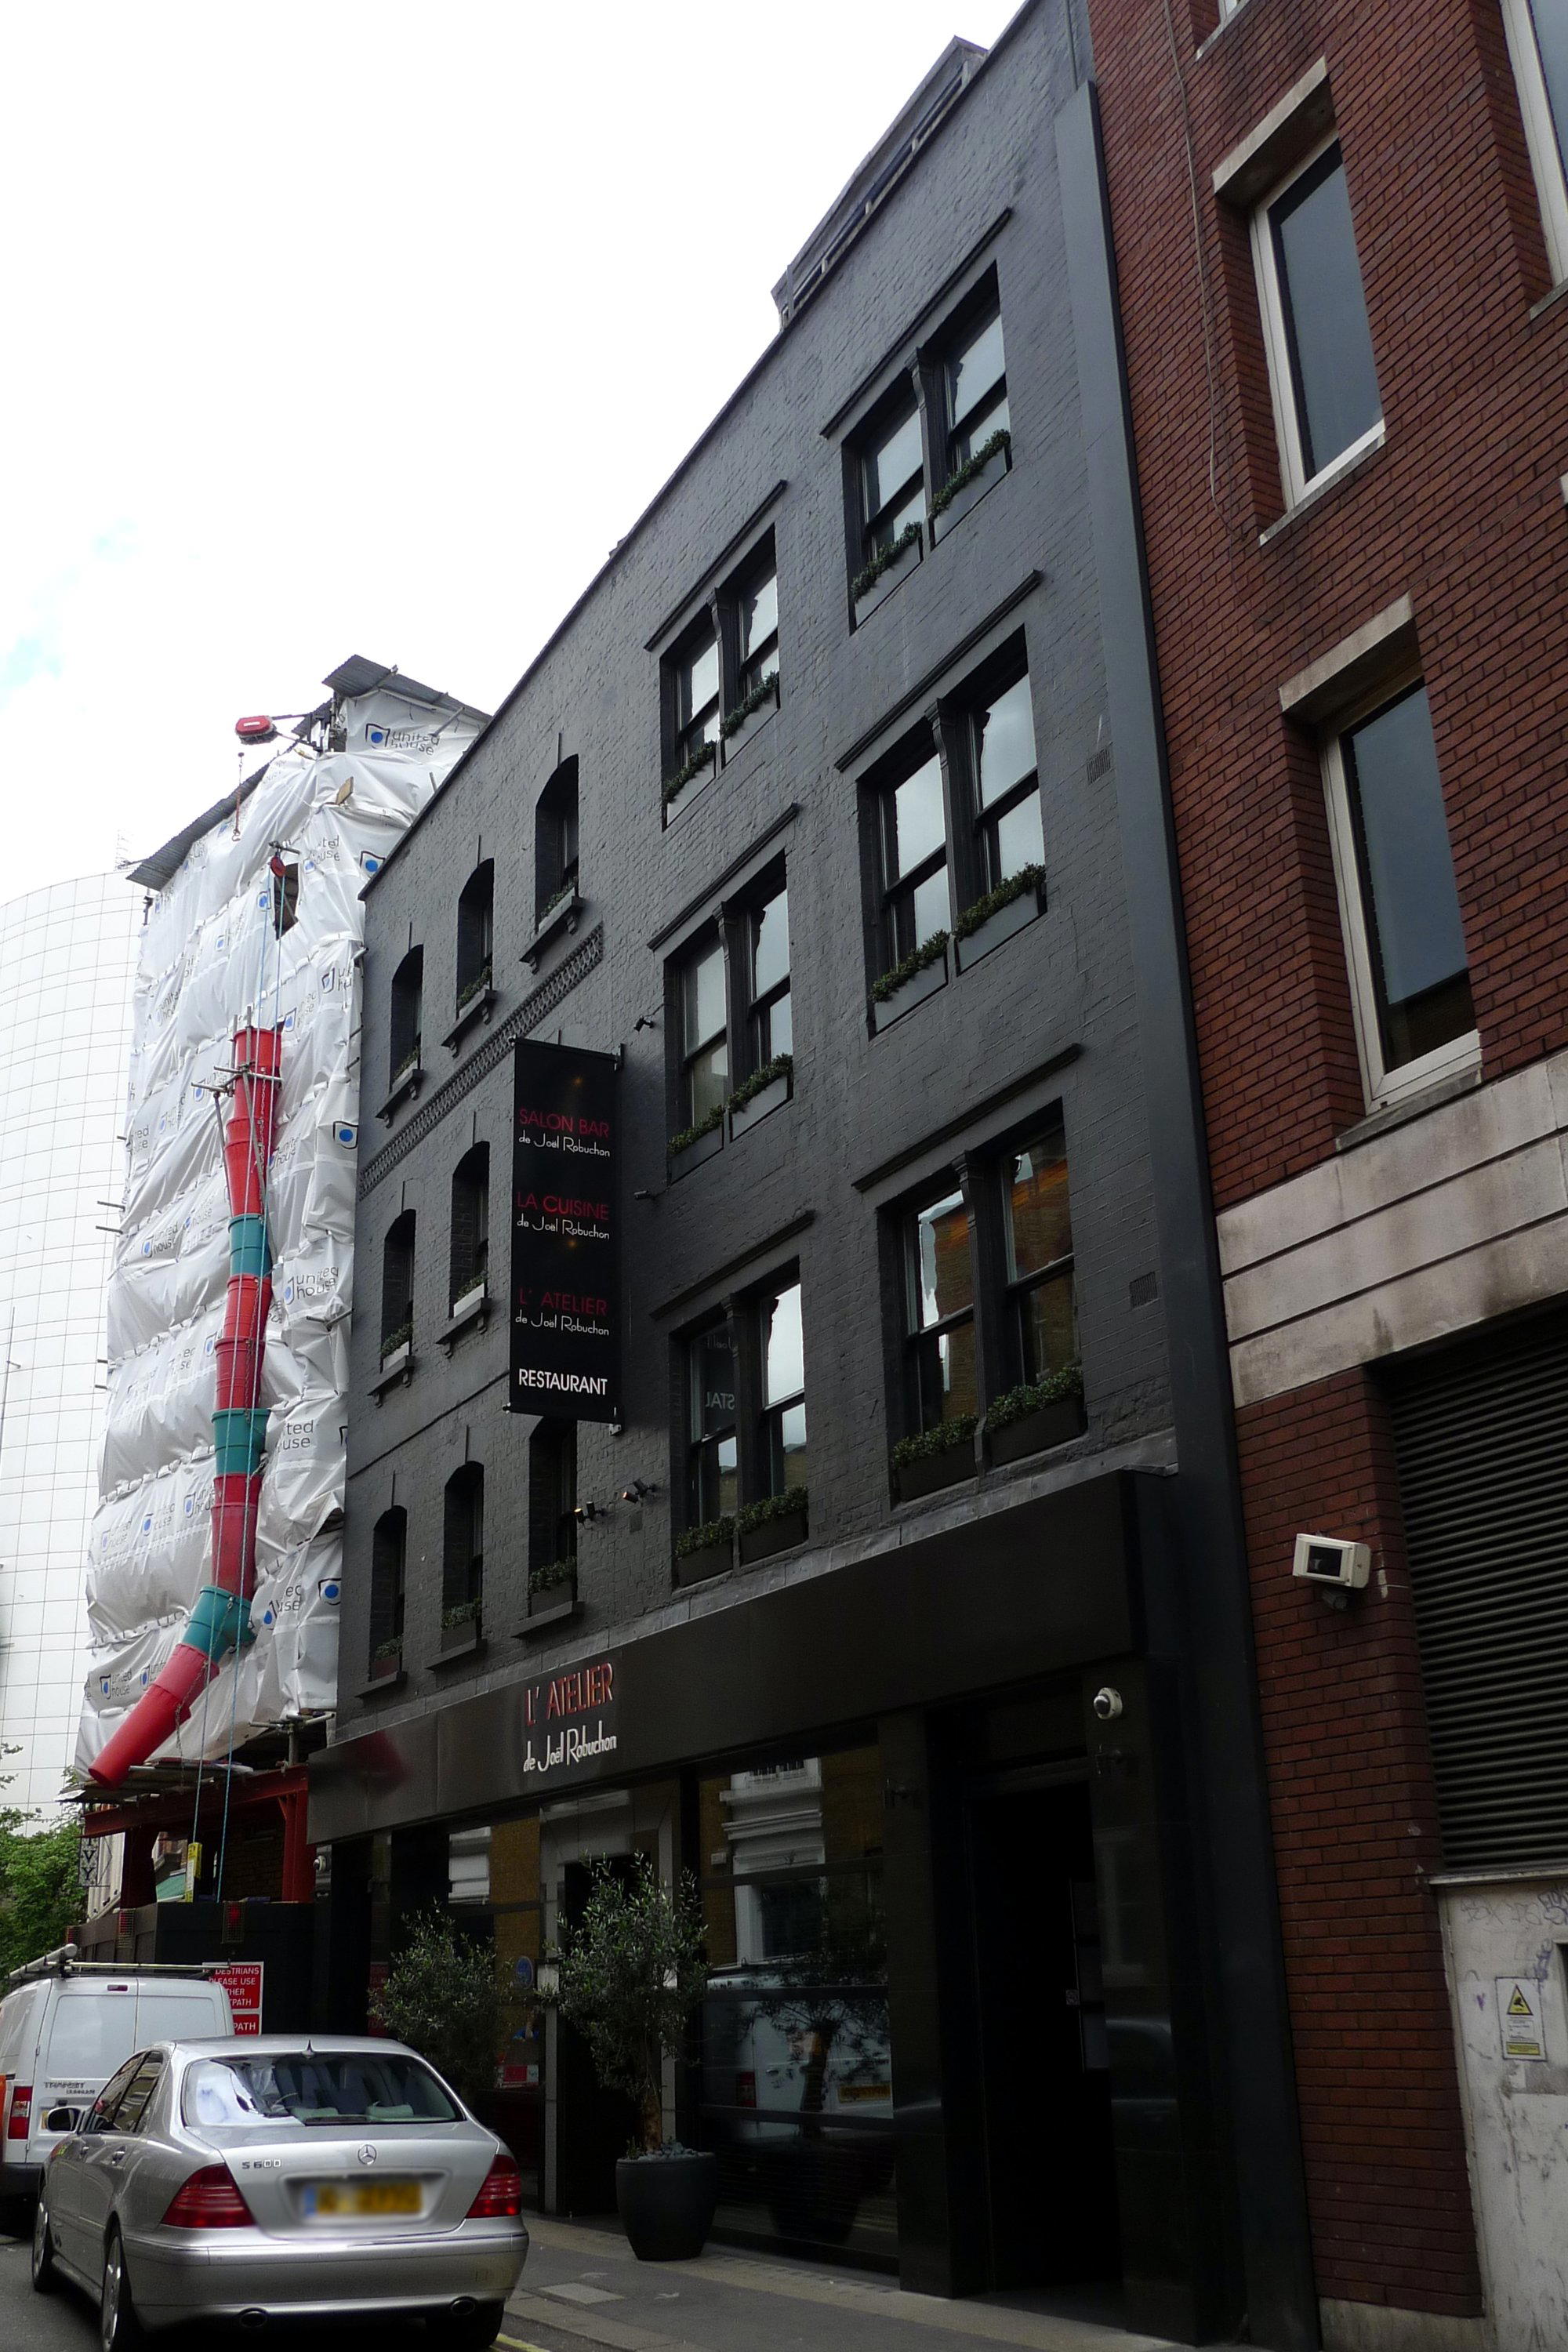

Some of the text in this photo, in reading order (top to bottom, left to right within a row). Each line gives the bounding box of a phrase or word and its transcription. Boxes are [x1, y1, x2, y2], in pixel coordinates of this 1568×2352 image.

[520, 1109, 609, 1138] SALON BAR
[519, 1130, 531, 1144] de
[564, 1137, 610, 1157] Robuchon
[517, 1192, 609, 1221] LA CUISINE
[517, 1213, 529, 1227] de
[562, 1219, 610, 1240] Robuchon
[297, 1267, 339, 1284] united
[297, 1277, 336, 1299] house
[541, 1291, 608, 1316] ATELIER
[515, 1308, 528, 1324] de
[561, 1316, 609, 1336] Robuchon
[519, 1368, 608, 1396] RESTAURANT
[546, 1663, 613, 1719] ATELIER
[524, 1720, 617, 1772] de Joël Robuchon
